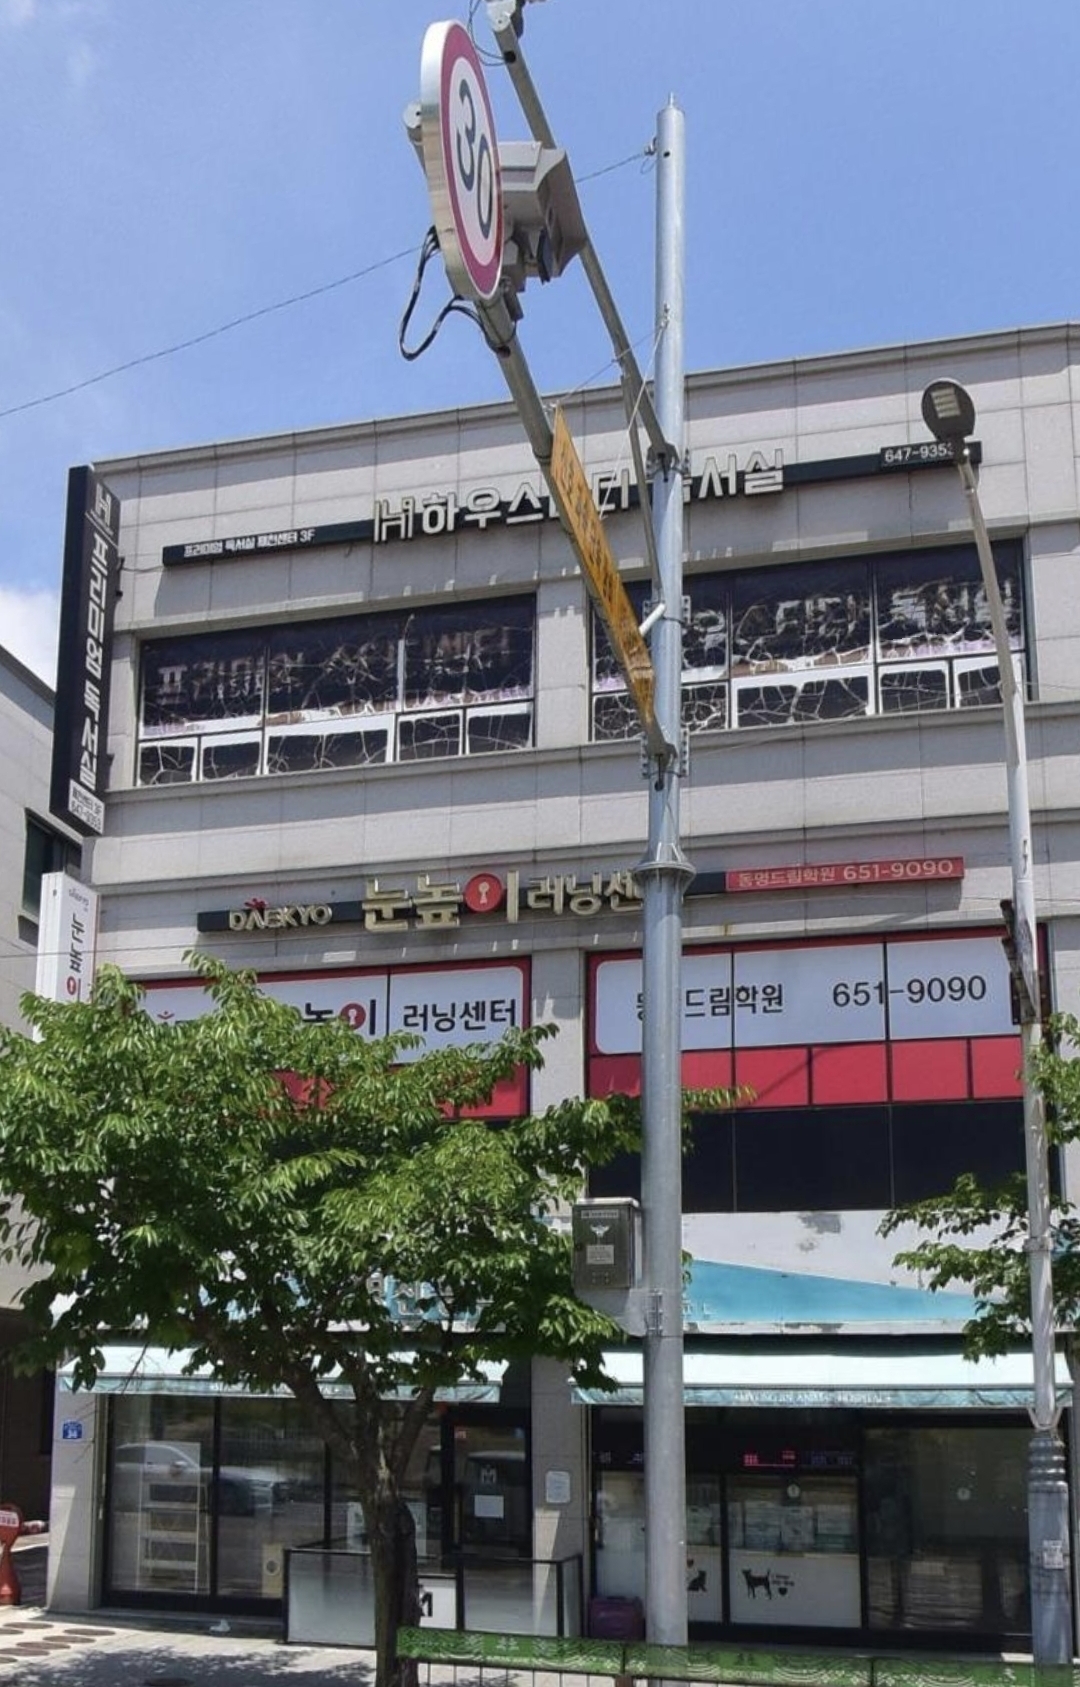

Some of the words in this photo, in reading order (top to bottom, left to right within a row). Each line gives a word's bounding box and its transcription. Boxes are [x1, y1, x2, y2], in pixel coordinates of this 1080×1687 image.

[456, 79, 493, 240] 30
[421, 468, 630, 535] 하우스디
[683, 447, 784, 502] 서실
[300, 528, 315, 542] 3F
[85, 532, 108, 680] 프리미엄
[79, 679, 101, 791] 독서실
[229, 904, 333, 931] DAEKYO
[362, 870, 519, 933] 눈높이
[527, 868, 645, 916] 러닝센
[738, 866, 836, 887] 동명드림학원
[843, 859, 953, 880] 651-9090
[403, 999, 515, 1032] 러닝센터
[637, 983, 783, 1021] 드림학원
[833, 975, 986, 1007] 651-9090
